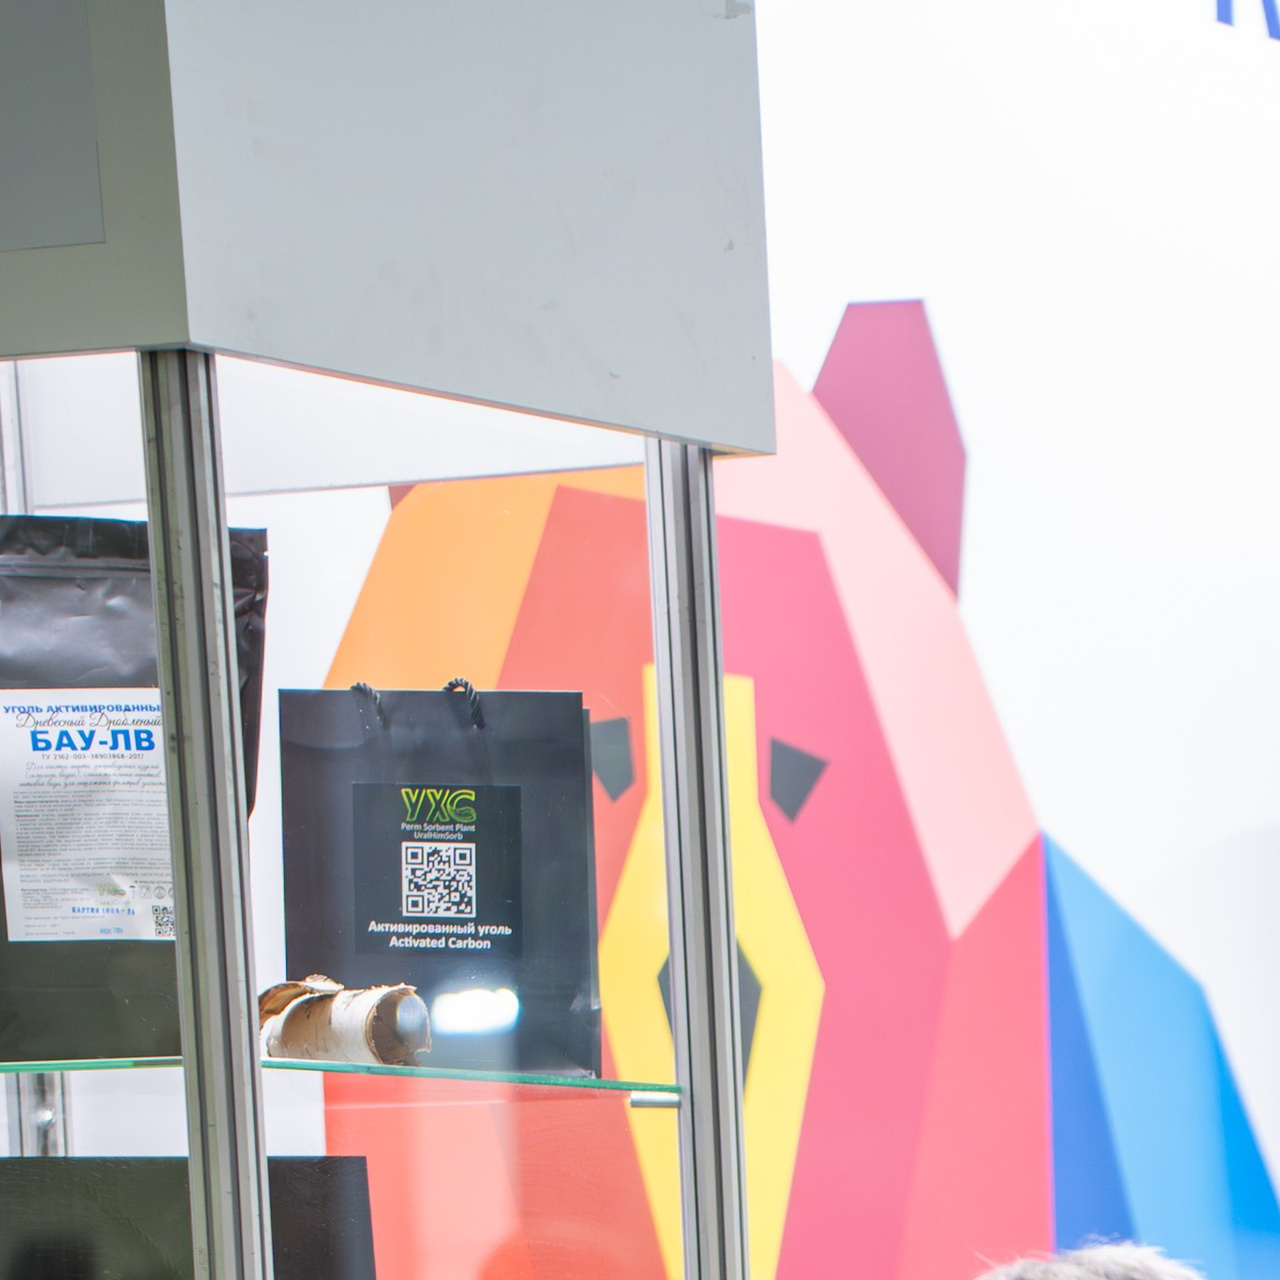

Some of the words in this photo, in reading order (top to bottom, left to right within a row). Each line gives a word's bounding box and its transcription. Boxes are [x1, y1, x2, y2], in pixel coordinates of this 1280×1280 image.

[3, 705, 43, 713] УГОЛЬ
[46, 704, 162, 714] АКТИВИРОВАННЫ
[30, 729, 155, 751] БАУ-ЛВ
[401, 823, 422, 831] Perm
[423, 823, 454, 832] Sorbent
[455, 823, 476, 832] Plant
[413, 831, 463, 840] UralHimSorb
[368, 920, 475, 935] Активированный
[478, 924, 512, 937] уголь
[389, 936, 446, 949] Activated
[448, 937, 491, 949] Carbon
